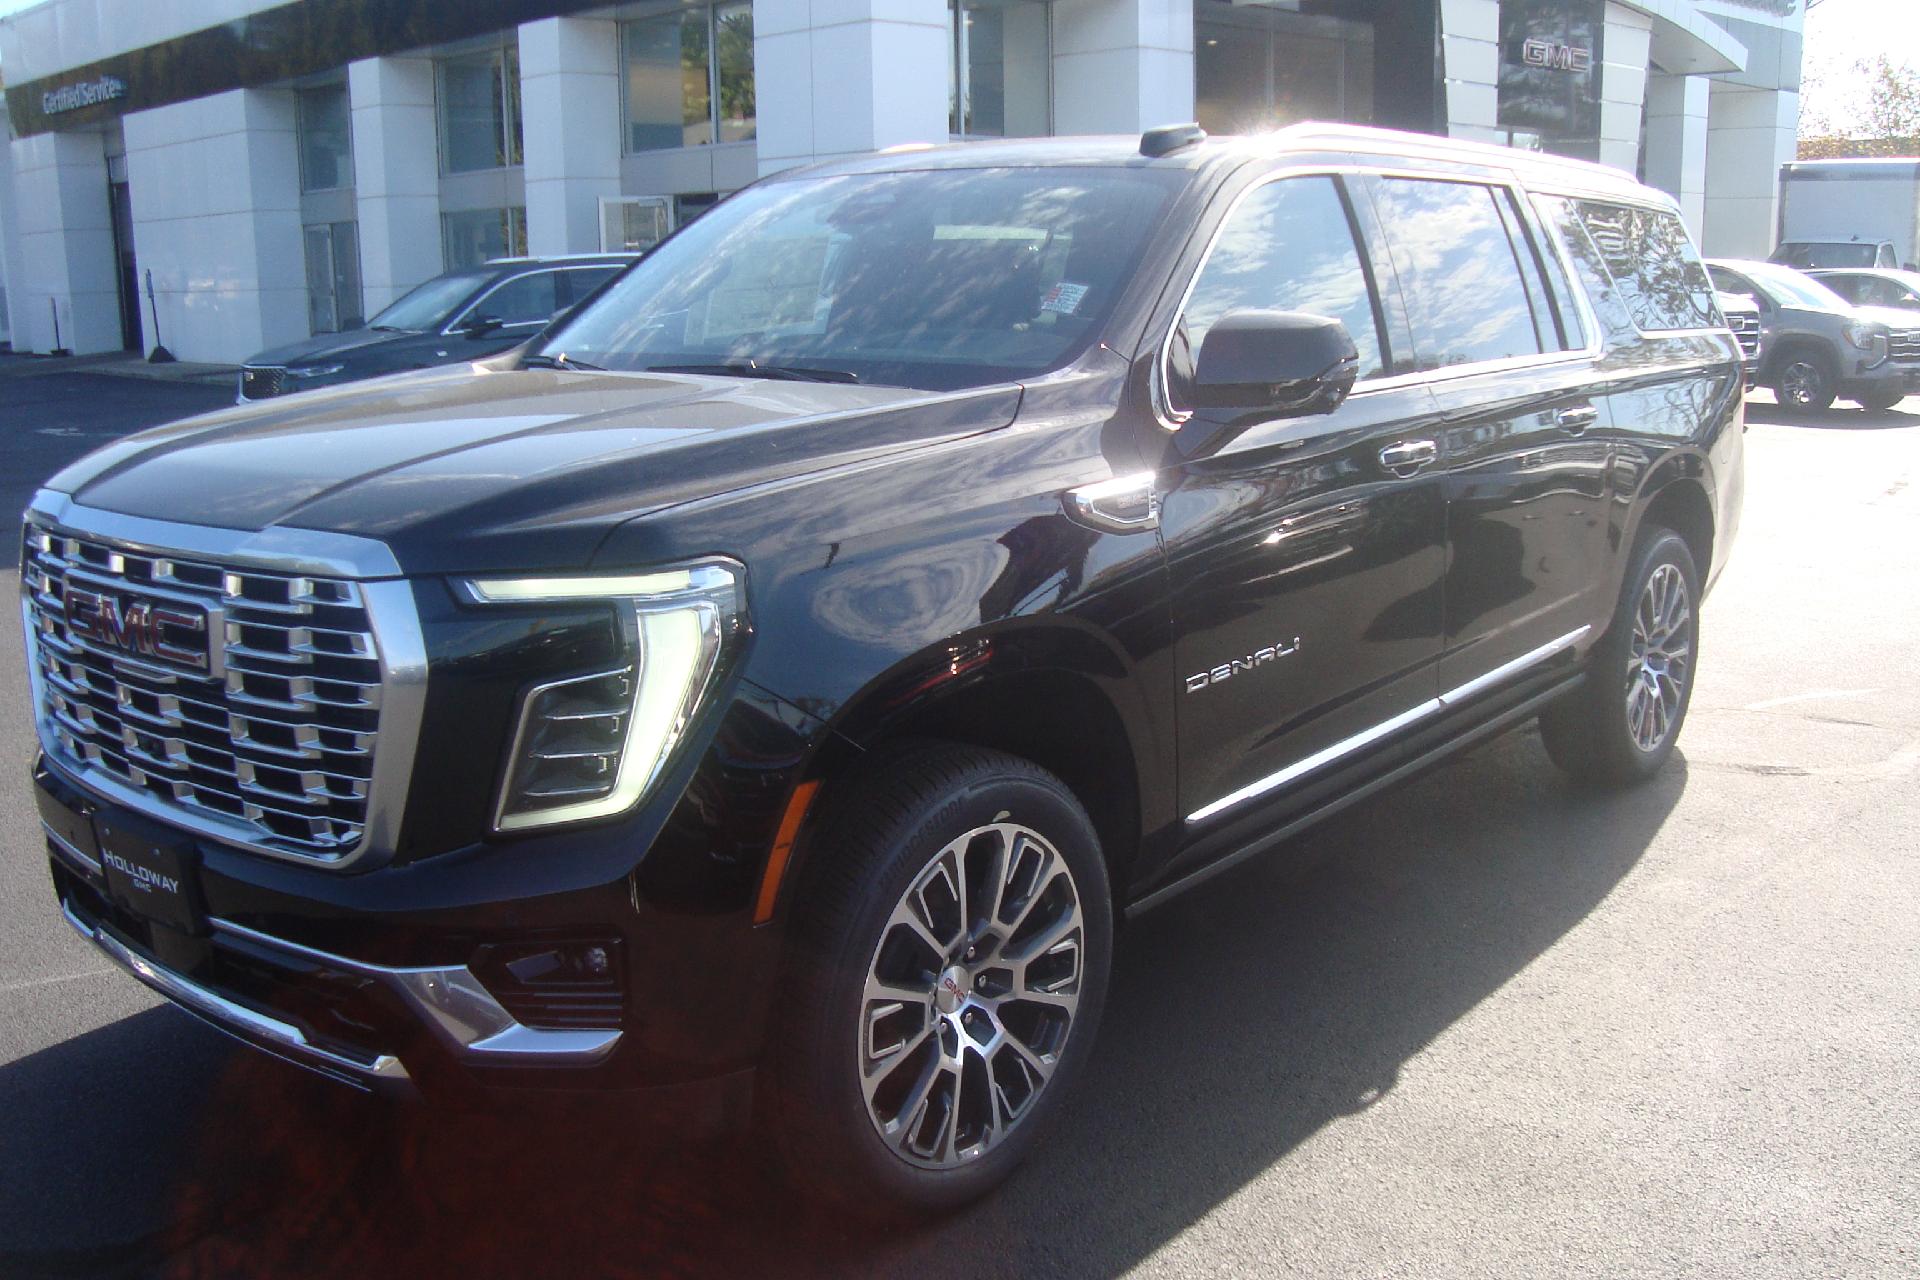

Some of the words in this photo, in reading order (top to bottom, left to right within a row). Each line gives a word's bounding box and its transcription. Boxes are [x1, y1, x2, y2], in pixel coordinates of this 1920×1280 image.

[1522, 38, 1590, 72] GMC
[43, 83, 80, 115] Certified
[80, 76, 116, 106] Service
[65, 586, 208, 669] GMC
[1185, 636, 1300, 694] DENALI
[102, 847, 179, 894] HOLLOWAY
[943, 977, 965, 1004] GMC
